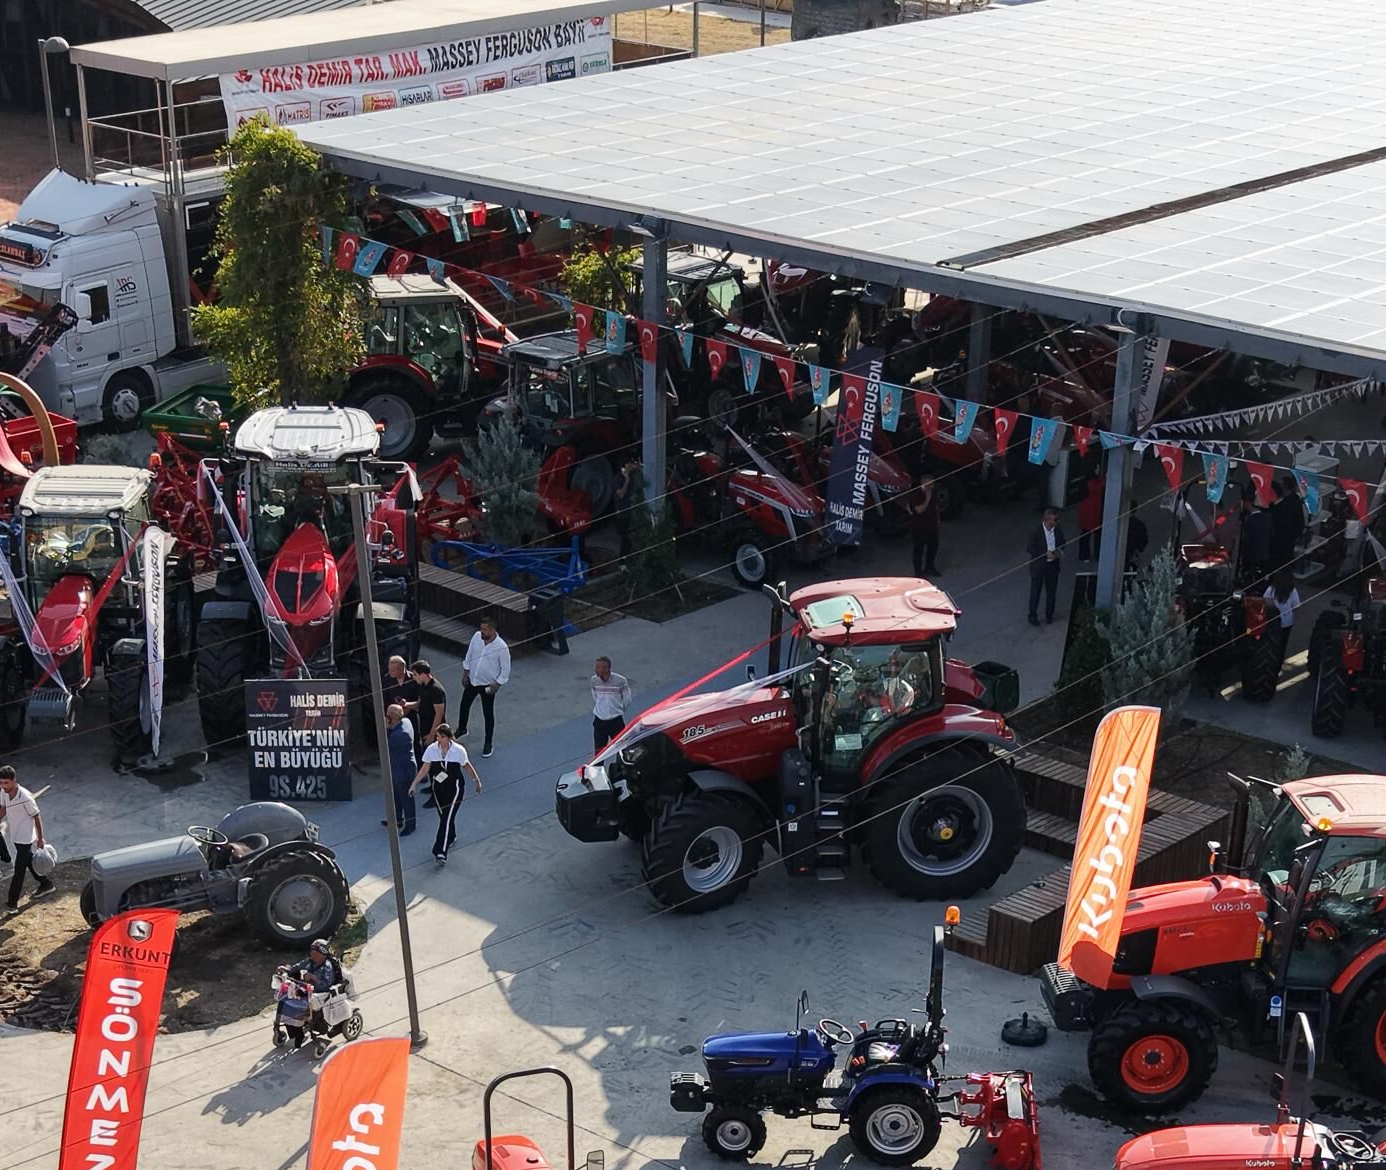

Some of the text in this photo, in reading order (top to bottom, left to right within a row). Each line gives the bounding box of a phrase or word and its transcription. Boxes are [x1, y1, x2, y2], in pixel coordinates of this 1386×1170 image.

[427, 38, 481, 73] MASSEY
[485, 25, 552, 62] FERGUSON
[853, 360, 883, 505] MASSEY FERGUSON
[289, 691, 346, 708] HALİS DEMİR
[751, 710, 777, 725] CASE
[247, 726, 345, 747] TÜRKİYE'NİN
[254, 748, 343, 768] EN BÜYÜĞÜ
[1077, 764, 1138, 939] Kubota
[1211, 901, 1251, 912] Kubota
[100, 941, 173, 965] ERKUNT
[1245, 1159, 1276, 1168] Kubota
